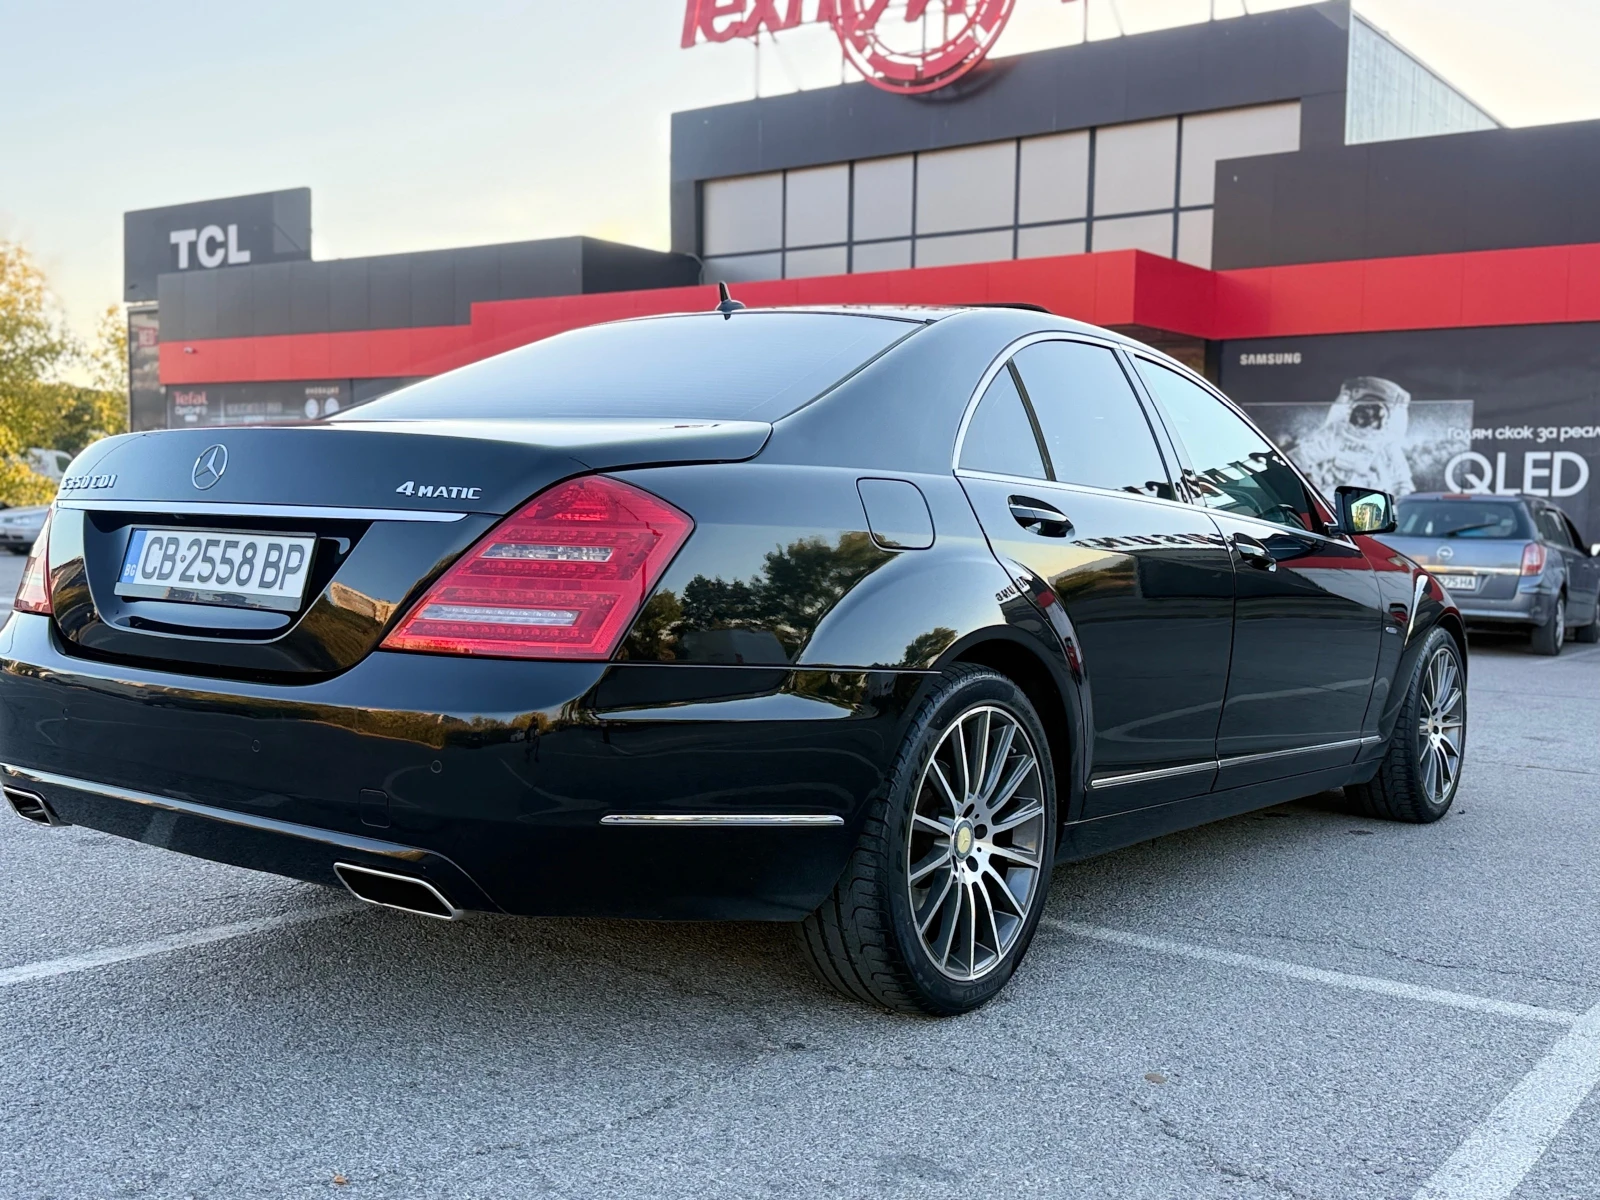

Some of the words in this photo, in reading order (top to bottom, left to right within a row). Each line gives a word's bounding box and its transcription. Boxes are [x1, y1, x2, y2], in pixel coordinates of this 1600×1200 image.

[170, 224, 251, 269] TCL
[1240, 352, 1302, 366] SAMSUNG
[1495, 425, 1534, 440] скок
[1536, 426, 1557, 443] за
[1444, 451, 1590, 498] QLED
[123, 563, 136, 577] BG
[178, 538, 258, 586] 2558
[258, 543, 305, 591] BP
